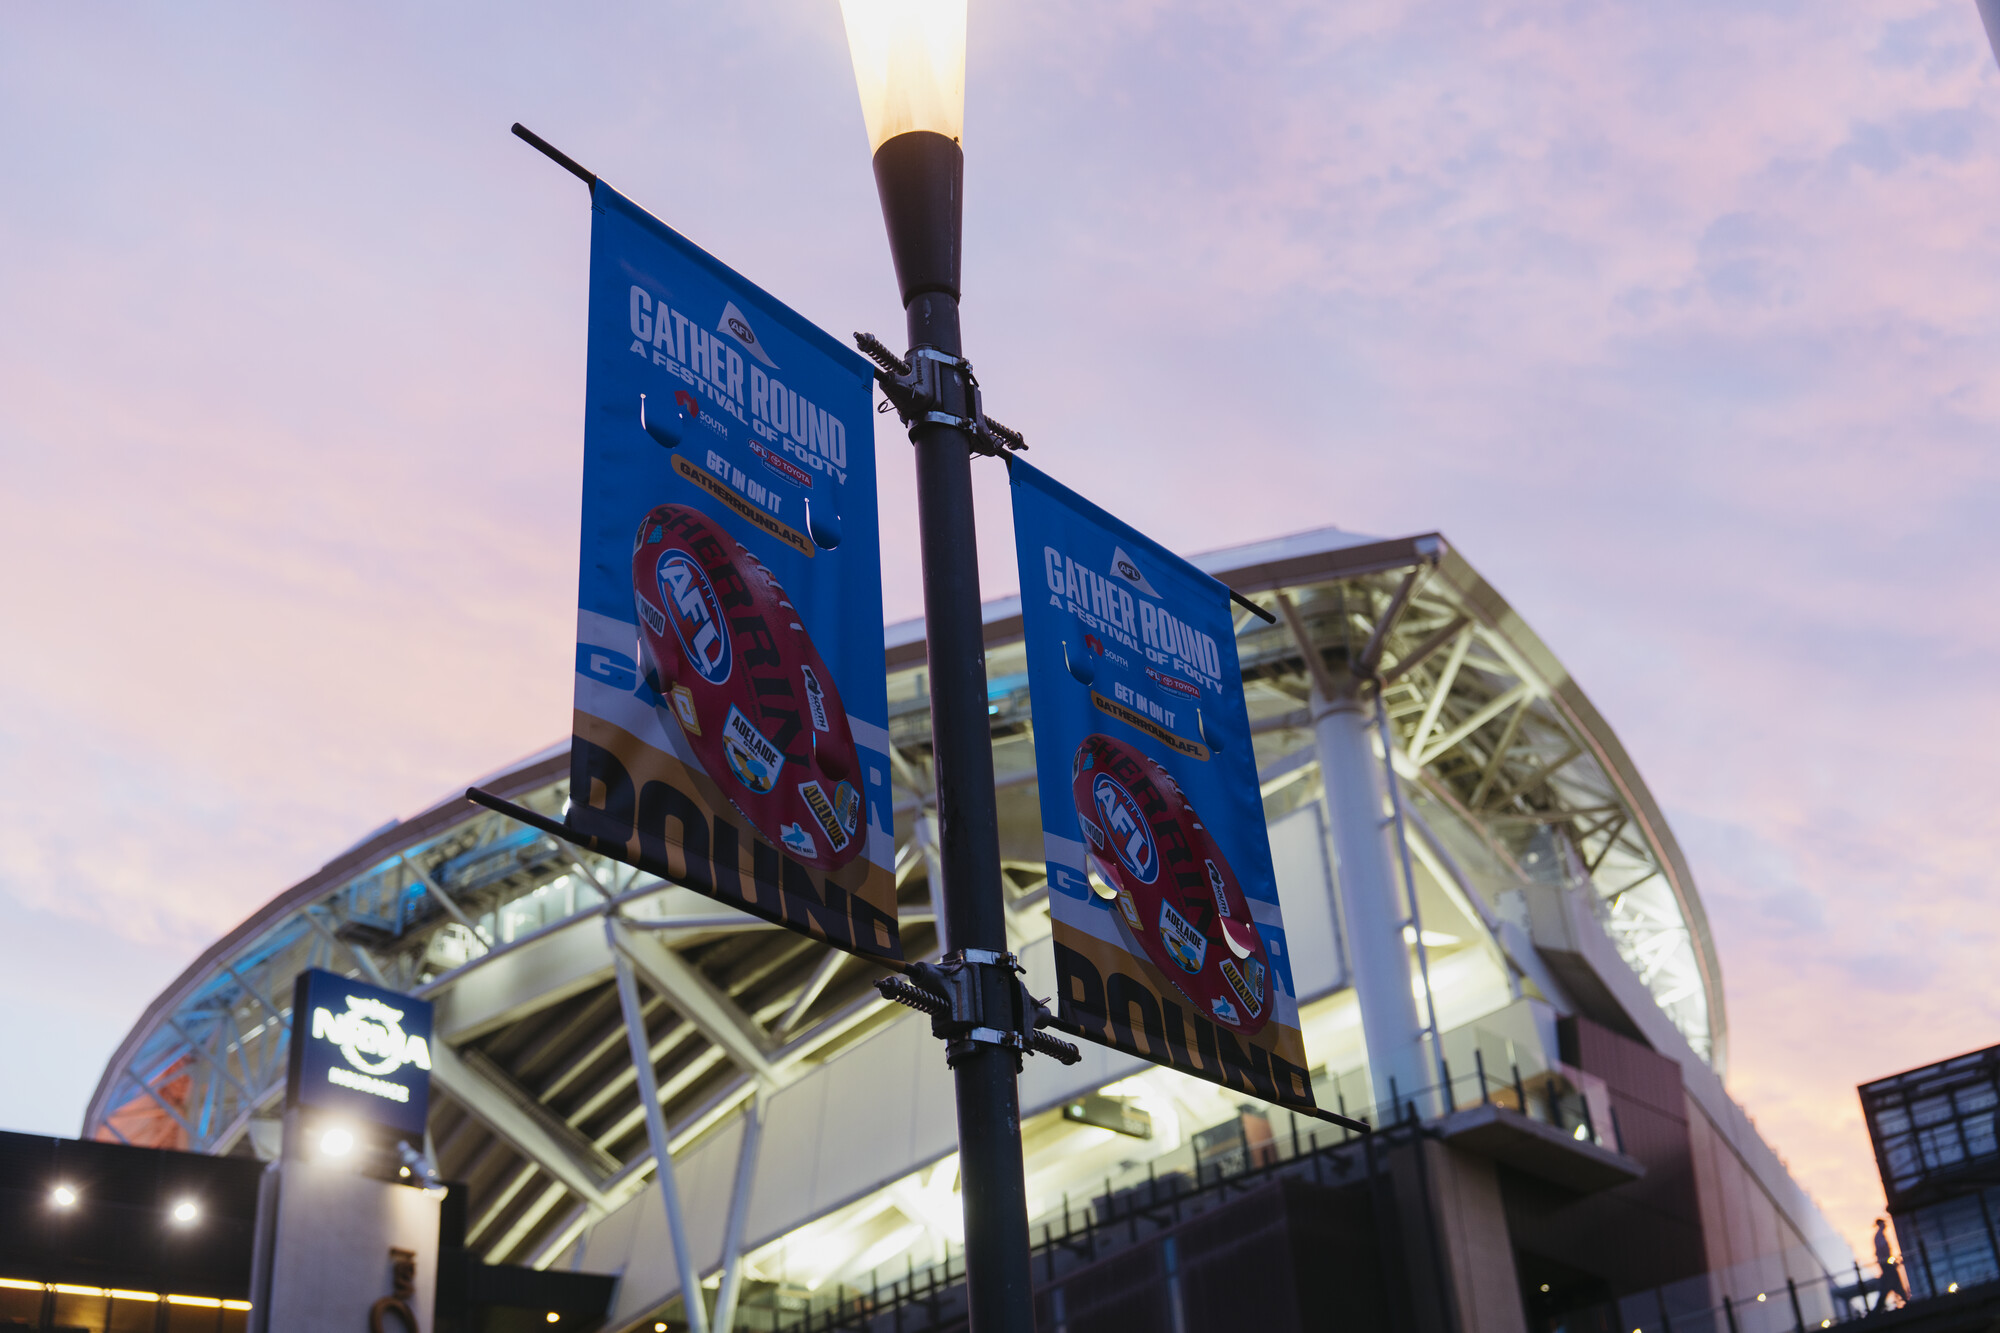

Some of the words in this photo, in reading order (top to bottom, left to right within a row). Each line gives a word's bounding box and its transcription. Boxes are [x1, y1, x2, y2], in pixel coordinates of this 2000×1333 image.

[729, 320, 753, 343] AFL
[630, 285, 744, 406] GATHER
[751, 363, 846, 469] ROUND
[629, 339, 647, 359] A
[653, 350, 748, 426] FESTIVAL
[753, 418, 777, 442] OF
[783, 436, 847, 485] FOOTY
[700, 410, 728, 437] SOUTH
[706, 450, 731, 480] GET
[732, 469, 746, 492] IN
[748, 479, 766, 505] ON
[769, 491, 782, 514] IT
[748, 441, 768, 458] AFL
[782, 462, 810, 485] TOYOTA
[680, 462, 808, 551] GATHERROUND.AFL
[1119, 564, 1139, 580] AFL
[647, 506, 810, 769] SHERRIN
[659, 561, 721, 676] AFL
[1044, 546, 1137, 638] GATHER
[1139, 599, 1221, 680] ROUND
[1049, 594, 1063, 609] A
[1067, 601, 1143, 655] FESTIVAL
[1146, 649, 1168, 665] OF
[1173, 657, 1223, 695] FOOTY
[1104, 649, 1128, 668] SOUTH
[813, 694, 827, 728] SOUTH
[1114, 682, 1134, 705] GET
[1136, 692, 1148, 714] IN
[1150, 701, 1163, 723] ON
[1164, 709, 1175, 728] IT
[1174, 681, 1199, 696] TOYOTA
[732, 716, 778, 768] ADELAIDE
[743, 740, 759, 757] OVAL
[1096, 697, 1203, 757] GATHERROUND.AFL
[803, 785, 846, 850] ADELAIDE
[1082, 736, 1225, 948] SHERRIN
[1095, 783, 1148, 877] AFL
[1217, 885, 1228, 914] SOUTH
[1165, 908, 1203, 950] ADELAIDE
[1223, 962, 1260, 1016] ADELAIDE
